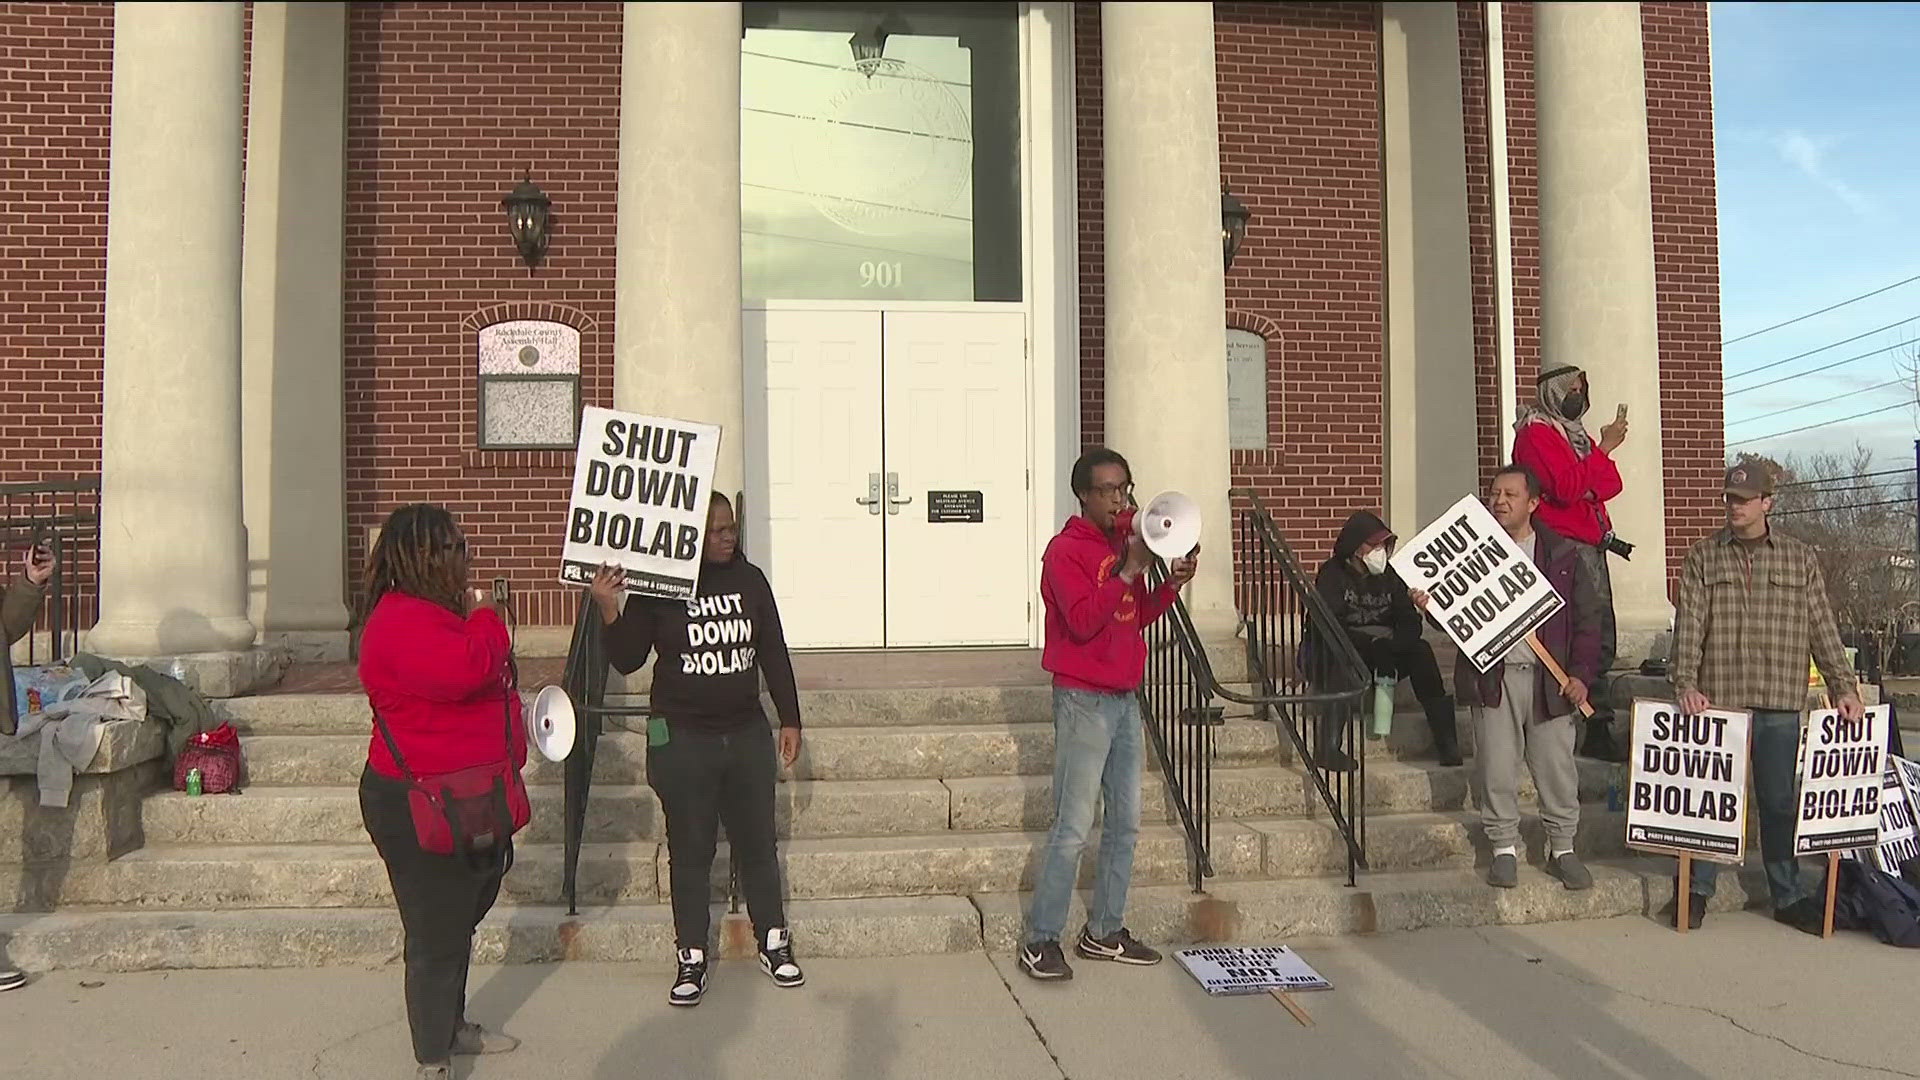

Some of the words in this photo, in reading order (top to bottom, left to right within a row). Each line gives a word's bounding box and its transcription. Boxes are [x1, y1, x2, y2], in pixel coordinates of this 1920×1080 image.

[859, 261, 904, 288] 901
[602, 419, 697, 468] SHUT
[585, 459, 699, 512] DOWN
[569, 506, 699, 561] BIOLAB
[1412, 513, 1480, 579] SHUT
[656, 583, 692, 595] LIBERATION
[1427, 535, 1510, 611] DOWN
[685, 593, 743, 618] SHUT
[1446, 560, 1538, 644] BIOLAB
[687, 619, 753, 647] DOWN
[1652, 711, 1728, 748] SHUT
[1820, 712, 1876, 745] SHUT
[1643, 743, 1733, 783] DOWN
[1810, 746, 1879, 779] DOWN
[1633, 781, 1737, 823] BIOLAB
[1802, 786, 1878, 821] BIOLAB
[1647, 833, 1664, 841] PARTY
[1674, 836, 1701, 845] SOCIALISM
[1706, 840, 1737, 850] LIBERATION
[1182, 947, 1245, 957] MONEY
[1202, 953, 1277, 961] DISASTER
[1217, 960, 1274, 968] RELIEF
[1206, 977, 1272, 986] GENOCIDE
[1285, 975, 1318, 983] WAR
[1225, 967, 1281, 978] NOT
